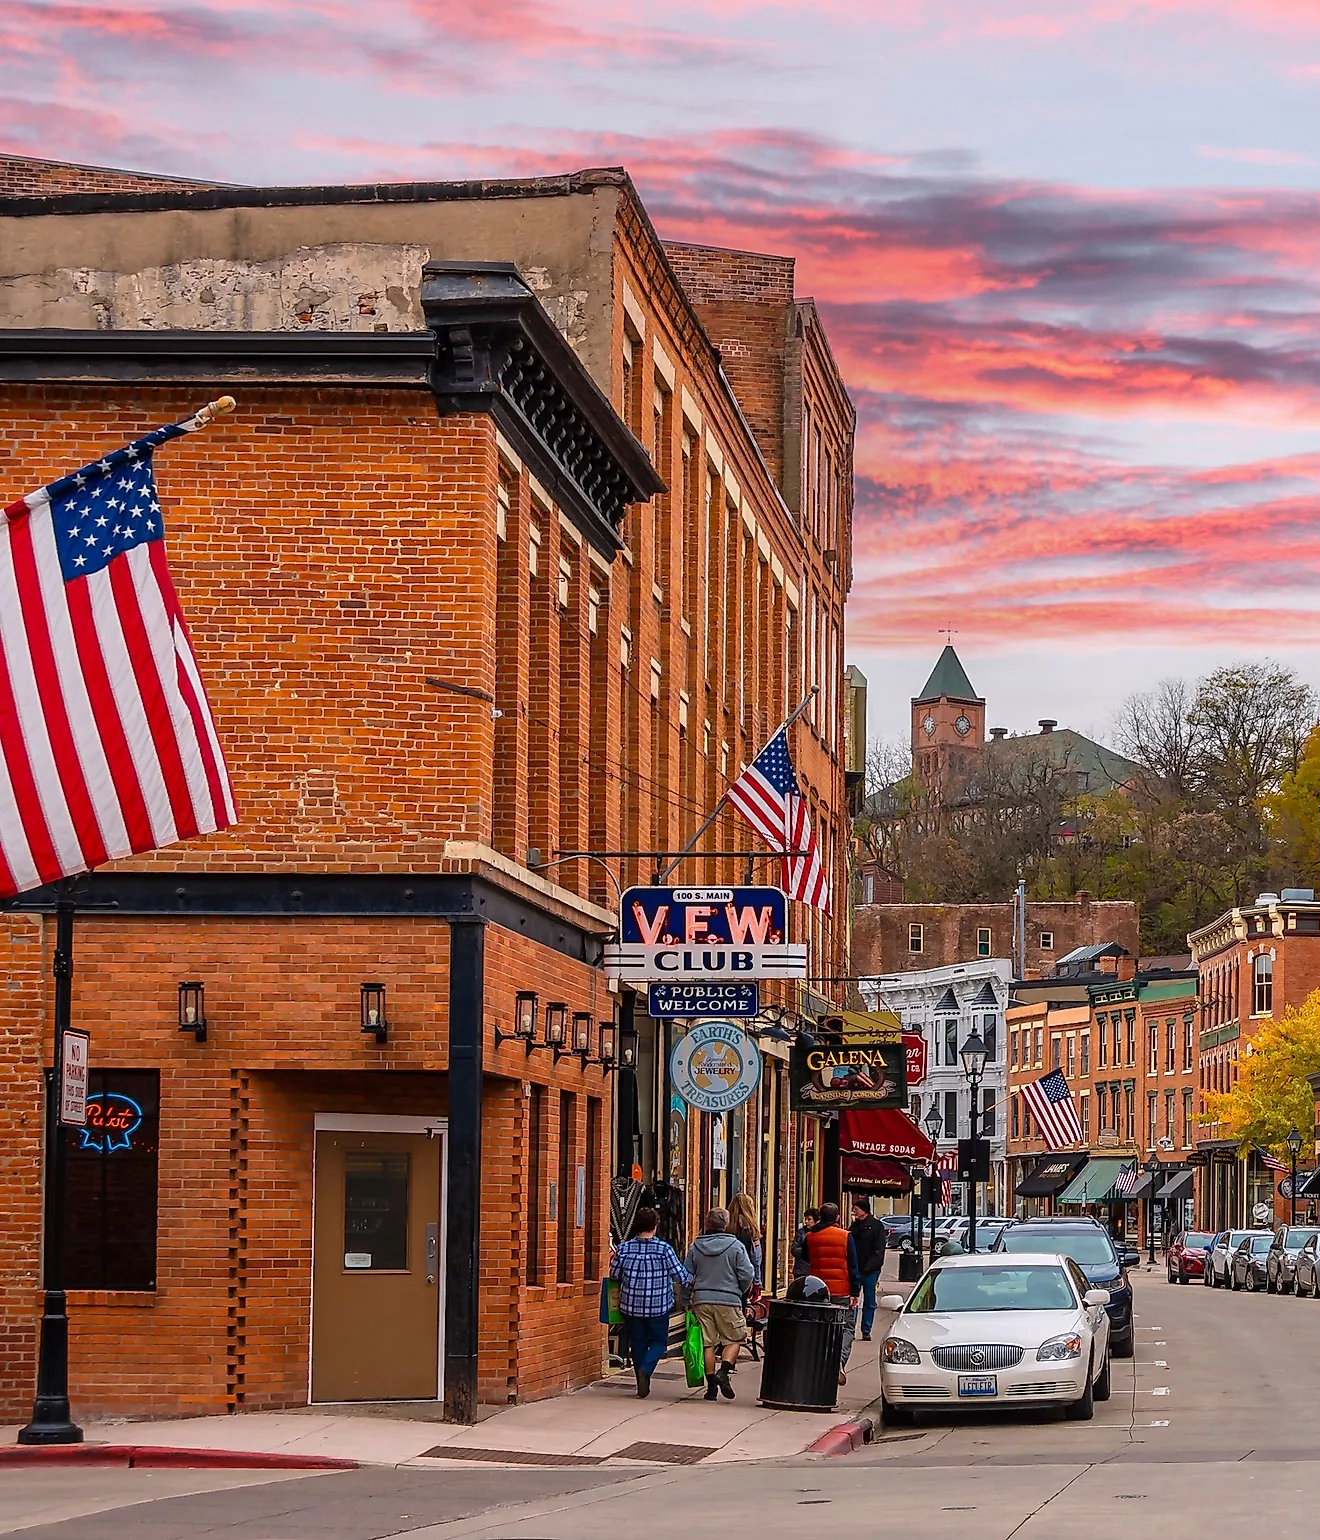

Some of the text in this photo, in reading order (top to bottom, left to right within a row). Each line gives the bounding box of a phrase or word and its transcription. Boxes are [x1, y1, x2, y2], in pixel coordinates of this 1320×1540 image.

[676, 892, 730, 900] 100 S. MAIN
[653, 951, 754, 971] CLUB
[670, 987, 737, 998] PUBLIC
[658, 1000, 749, 1011] WELCOME
[690, 1026, 743, 1045] EARTH'S
[71, 1043, 81, 1062] NO
[806, 1049, 888, 1071] GALENA
[65, 1063, 86, 1083] PARKING
[694, 1067, 736, 1075] JEWELRY
[65, 1085, 84, 1098] THIS SIDE
[680, 1080, 750, 1108] TREASURES
[813, 1091, 885, 1100] CANNING COMPANY
[65, 1100, 83, 1114] OF STREET
[85, 1103, 134, 1129] Pabst
[851, 1140, 916, 1155] VINTAGE SODAS
